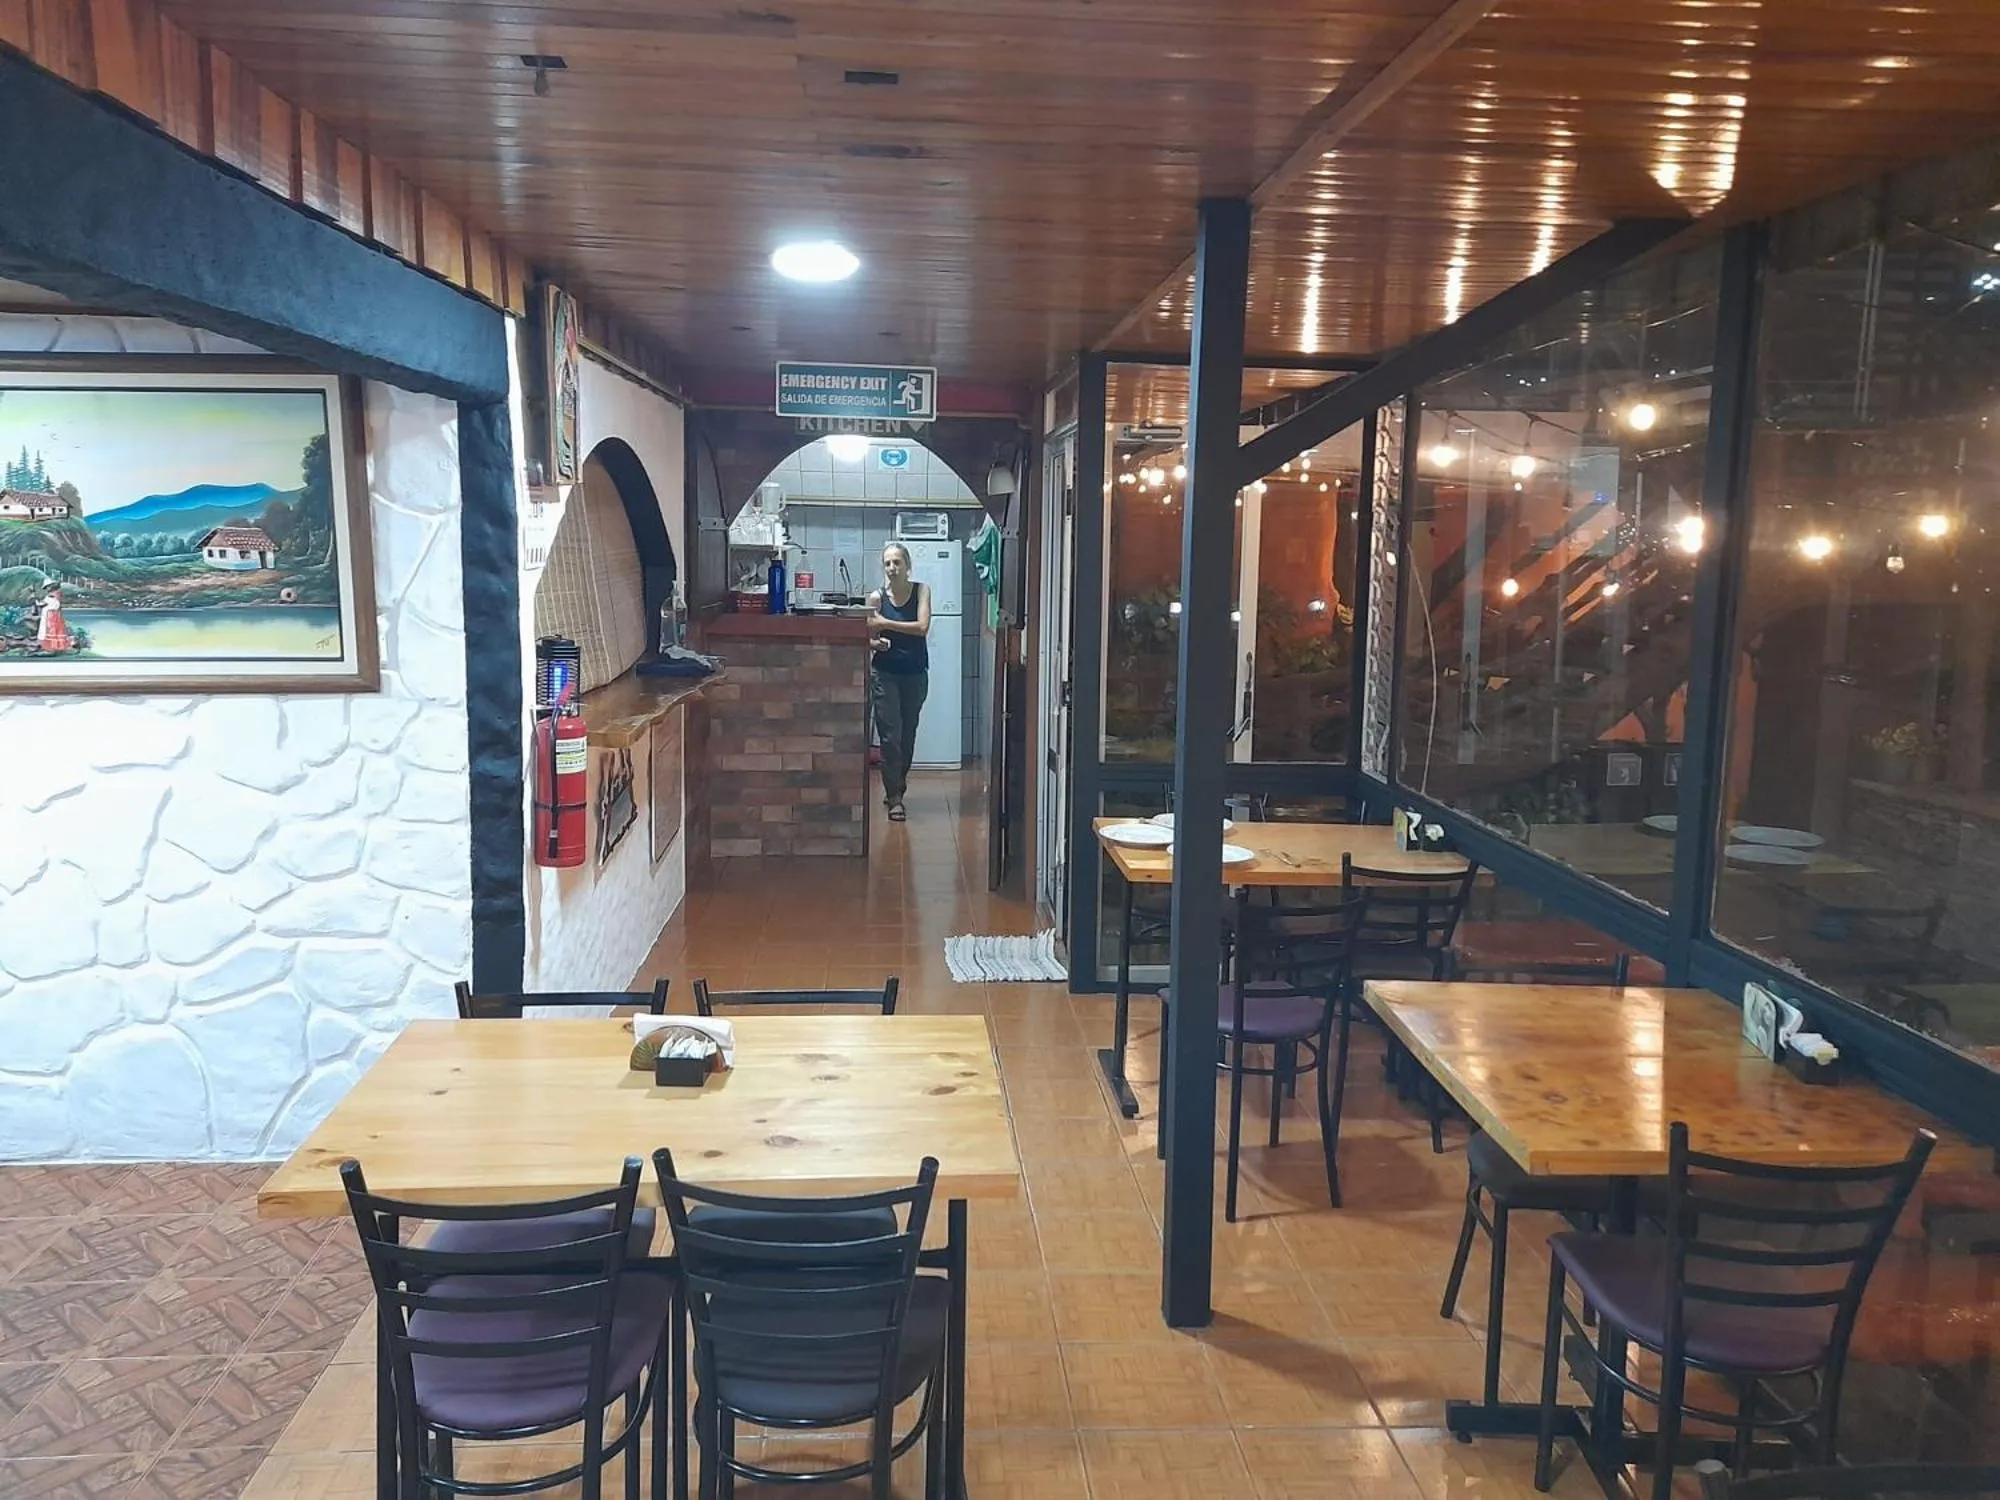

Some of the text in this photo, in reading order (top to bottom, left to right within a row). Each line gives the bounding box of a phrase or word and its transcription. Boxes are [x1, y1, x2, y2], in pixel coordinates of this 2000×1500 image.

[781, 374, 887, 391] EMERGENCY EXIT
[781, 393, 887, 407] SALIDA DE EMERGENCIA
[800, 417, 901, 433] KITCHEN
